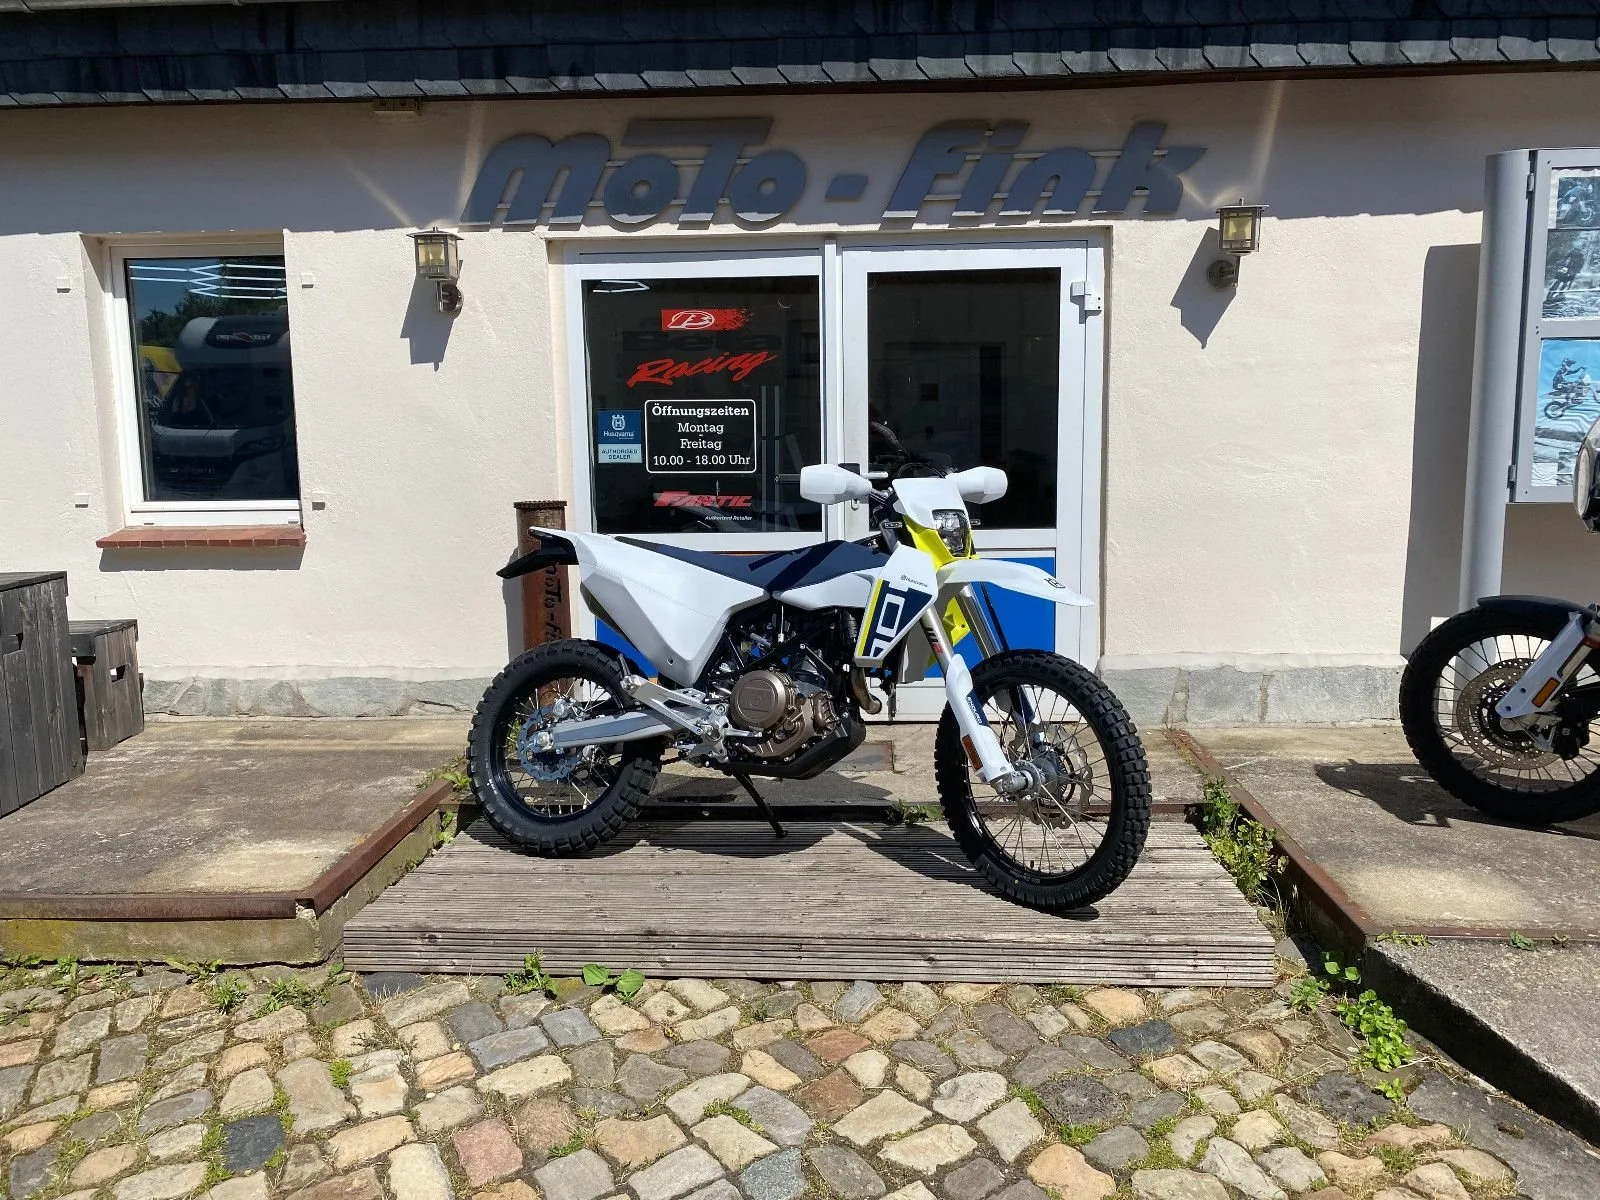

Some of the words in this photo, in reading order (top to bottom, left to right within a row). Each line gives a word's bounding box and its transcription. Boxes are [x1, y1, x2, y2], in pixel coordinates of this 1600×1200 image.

[627, 352, 777, 388] Racing
[652, 403, 749, 418] Öffnungszeiten
[677, 423, 724, 435] Montag
[680, 439, 722, 451] Freitag
[653, 456, 684, 466] 10.00
[695, 455, 726, 465] 18.00
[728, 455, 751, 465] Uhr
